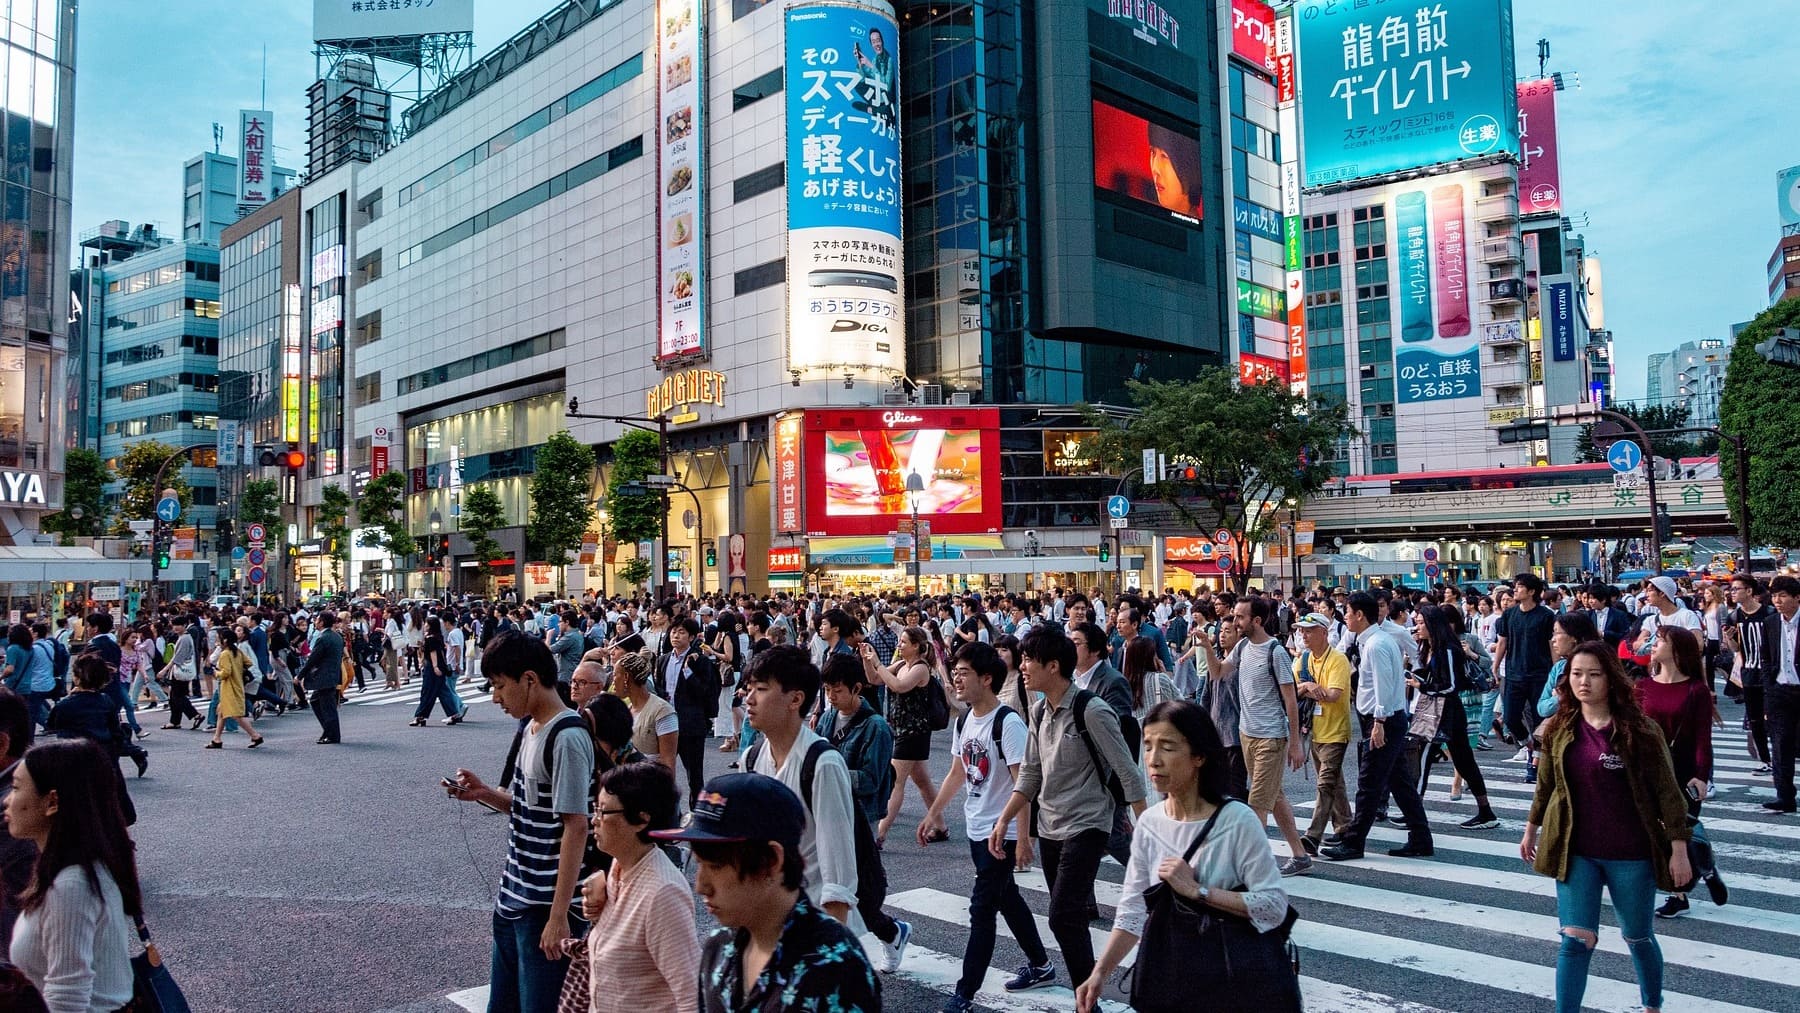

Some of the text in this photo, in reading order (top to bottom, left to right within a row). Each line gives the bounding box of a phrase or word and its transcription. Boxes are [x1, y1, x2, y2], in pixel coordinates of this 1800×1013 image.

[790, 11, 828, 22] Panasonic
[1233, 7, 1276, 48] アイフル
[1342, 4, 1448, 71] 龍角散
[801, 47, 839, 65] その
[1281, 66, 1293, 102] アイフル
[1329, 55, 1472, 120] ダイレクト
[801, 105, 897, 141] ディーガが
[1343, 119, 1401, 141] スティック
[1407, 116, 1431, 127] ミント
[1462, 125, 1500, 145] 生薬
[245, 117, 264, 184] 大和証券
[802, 133, 897, 184] 軽くして
[802, 177, 898, 207] あげましょう!
[1532, 192, 1555, 203] 生薬
[1235, 205, 1280, 236] レオパレス21
[812, 240, 896, 256] スマホの写真や動画は
[1559, 288, 1567, 320] MIZUHO
[675, 320, 683, 332] 7F
[830, 319, 889, 334] DIGA
[1291, 325, 1303, 357] アコム
[1400, 360, 1479, 380] のど、直接、
[647, 369, 726, 420] MAGNET
[1408, 380, 1468, 400] うるおう
[882, 411, 923, 427] Glico
[0, 471, 46, 504] YA
[782, 437, 796, 529] 天津甘栗
[1549, 491, 1571, 505] JR
